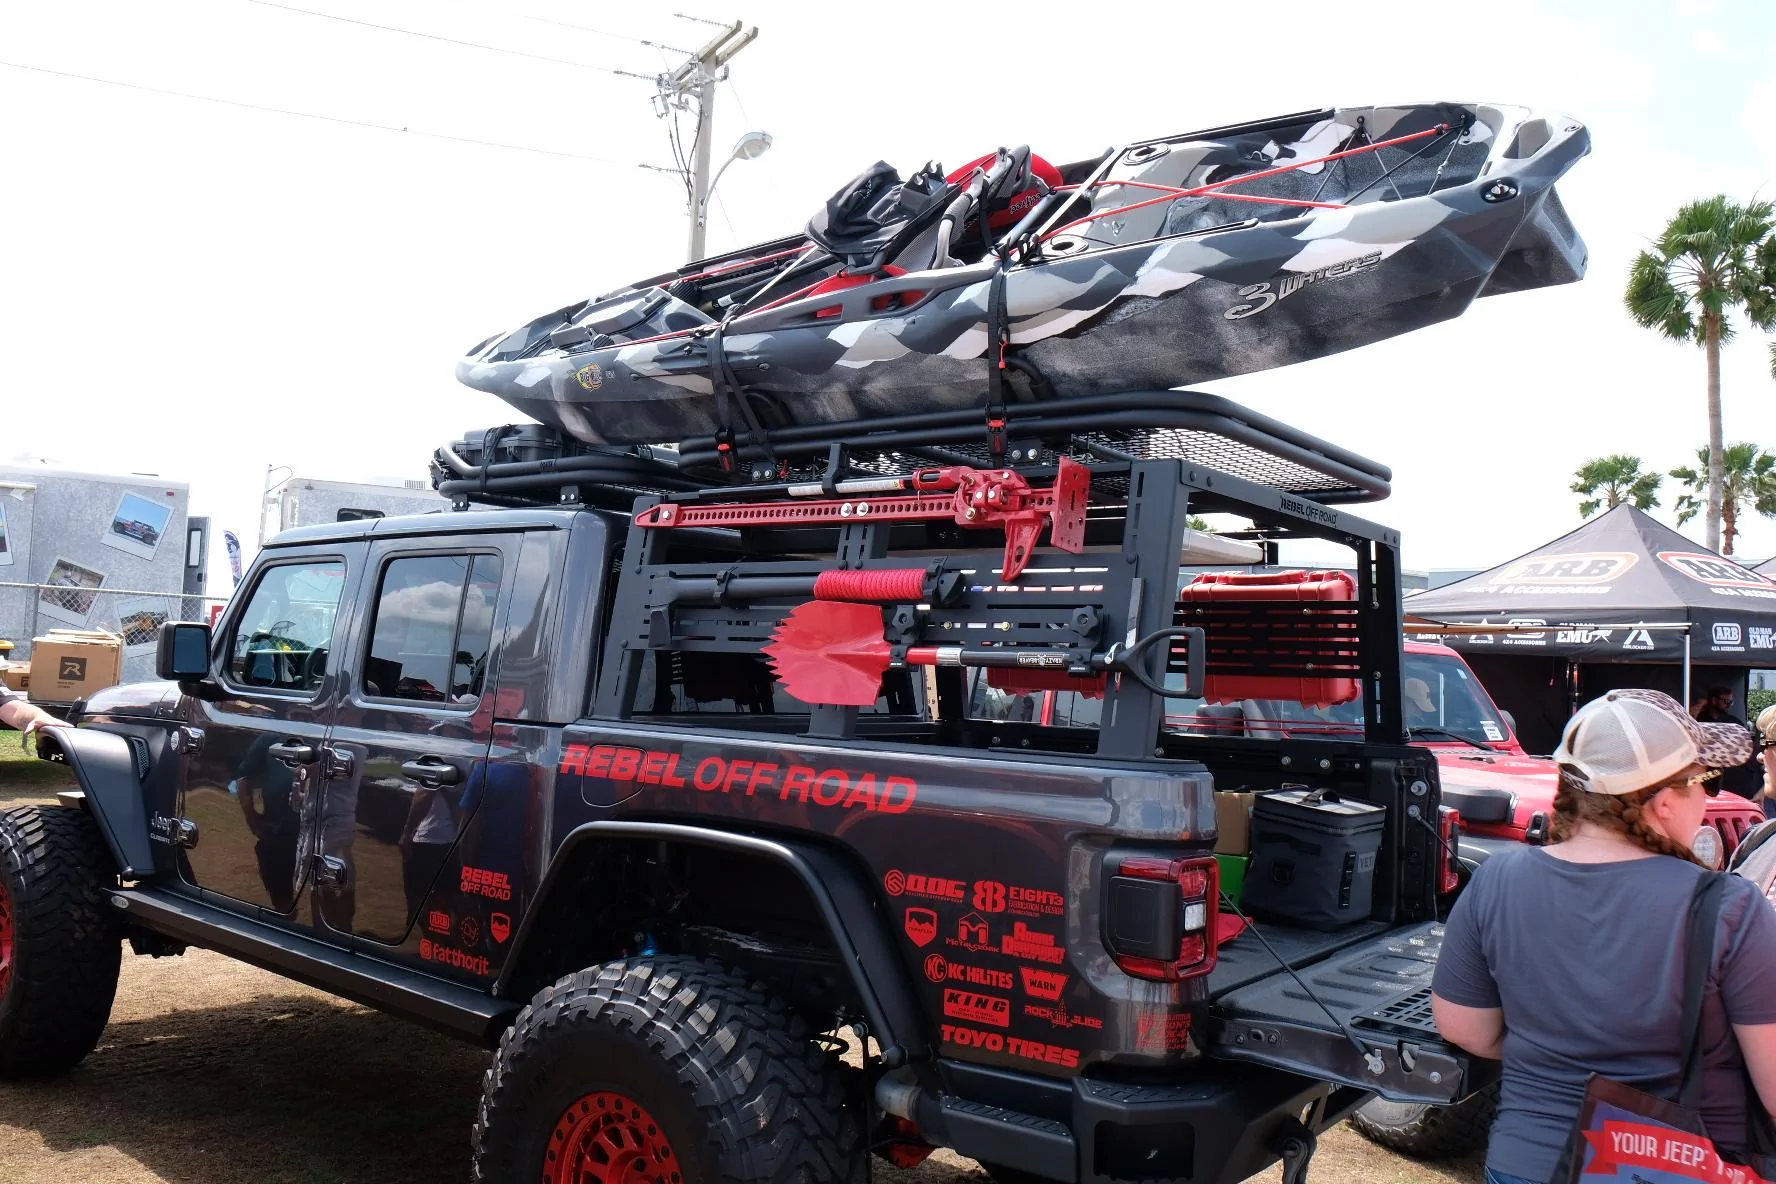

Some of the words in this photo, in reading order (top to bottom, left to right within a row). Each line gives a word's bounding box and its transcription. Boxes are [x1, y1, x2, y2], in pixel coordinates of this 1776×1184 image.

[1280, 498, 1305, 516] REBEL
[1305, 505, 1319, 519] OFF
[1319, 510, 1338, 525] ROAD
[1515, 559, 1620, 578] ARB
[1556, 630, 1592, 643] EMU
[1715, 626, 1739, 641] ARB
[1749, 634, 1773, 648] EMU
[560, 744, 687, 788] REBEL
[693, 757, 777, 797] OFF
[779, 766, 918, 815] ROAD
[461, 865, 511, 889] REBEL
[460, 881, 481, 894] OFF
[480, 885, 511, 901] ROAD
[947, 963, 965, 980] KC
[1029, 979, 1056, 991] WARN
[946, 991, 1007, 1012] KING
[1024, 1005, 1053, 1019] ROCK
[1070, 1015, 1103, 1029] SLIDE
[941, 1024, 1004, 1051] TOYO
[1006, 1036, 1081, 1068] TIRES
[1610, 1131, 1658, 1159] YOUR
